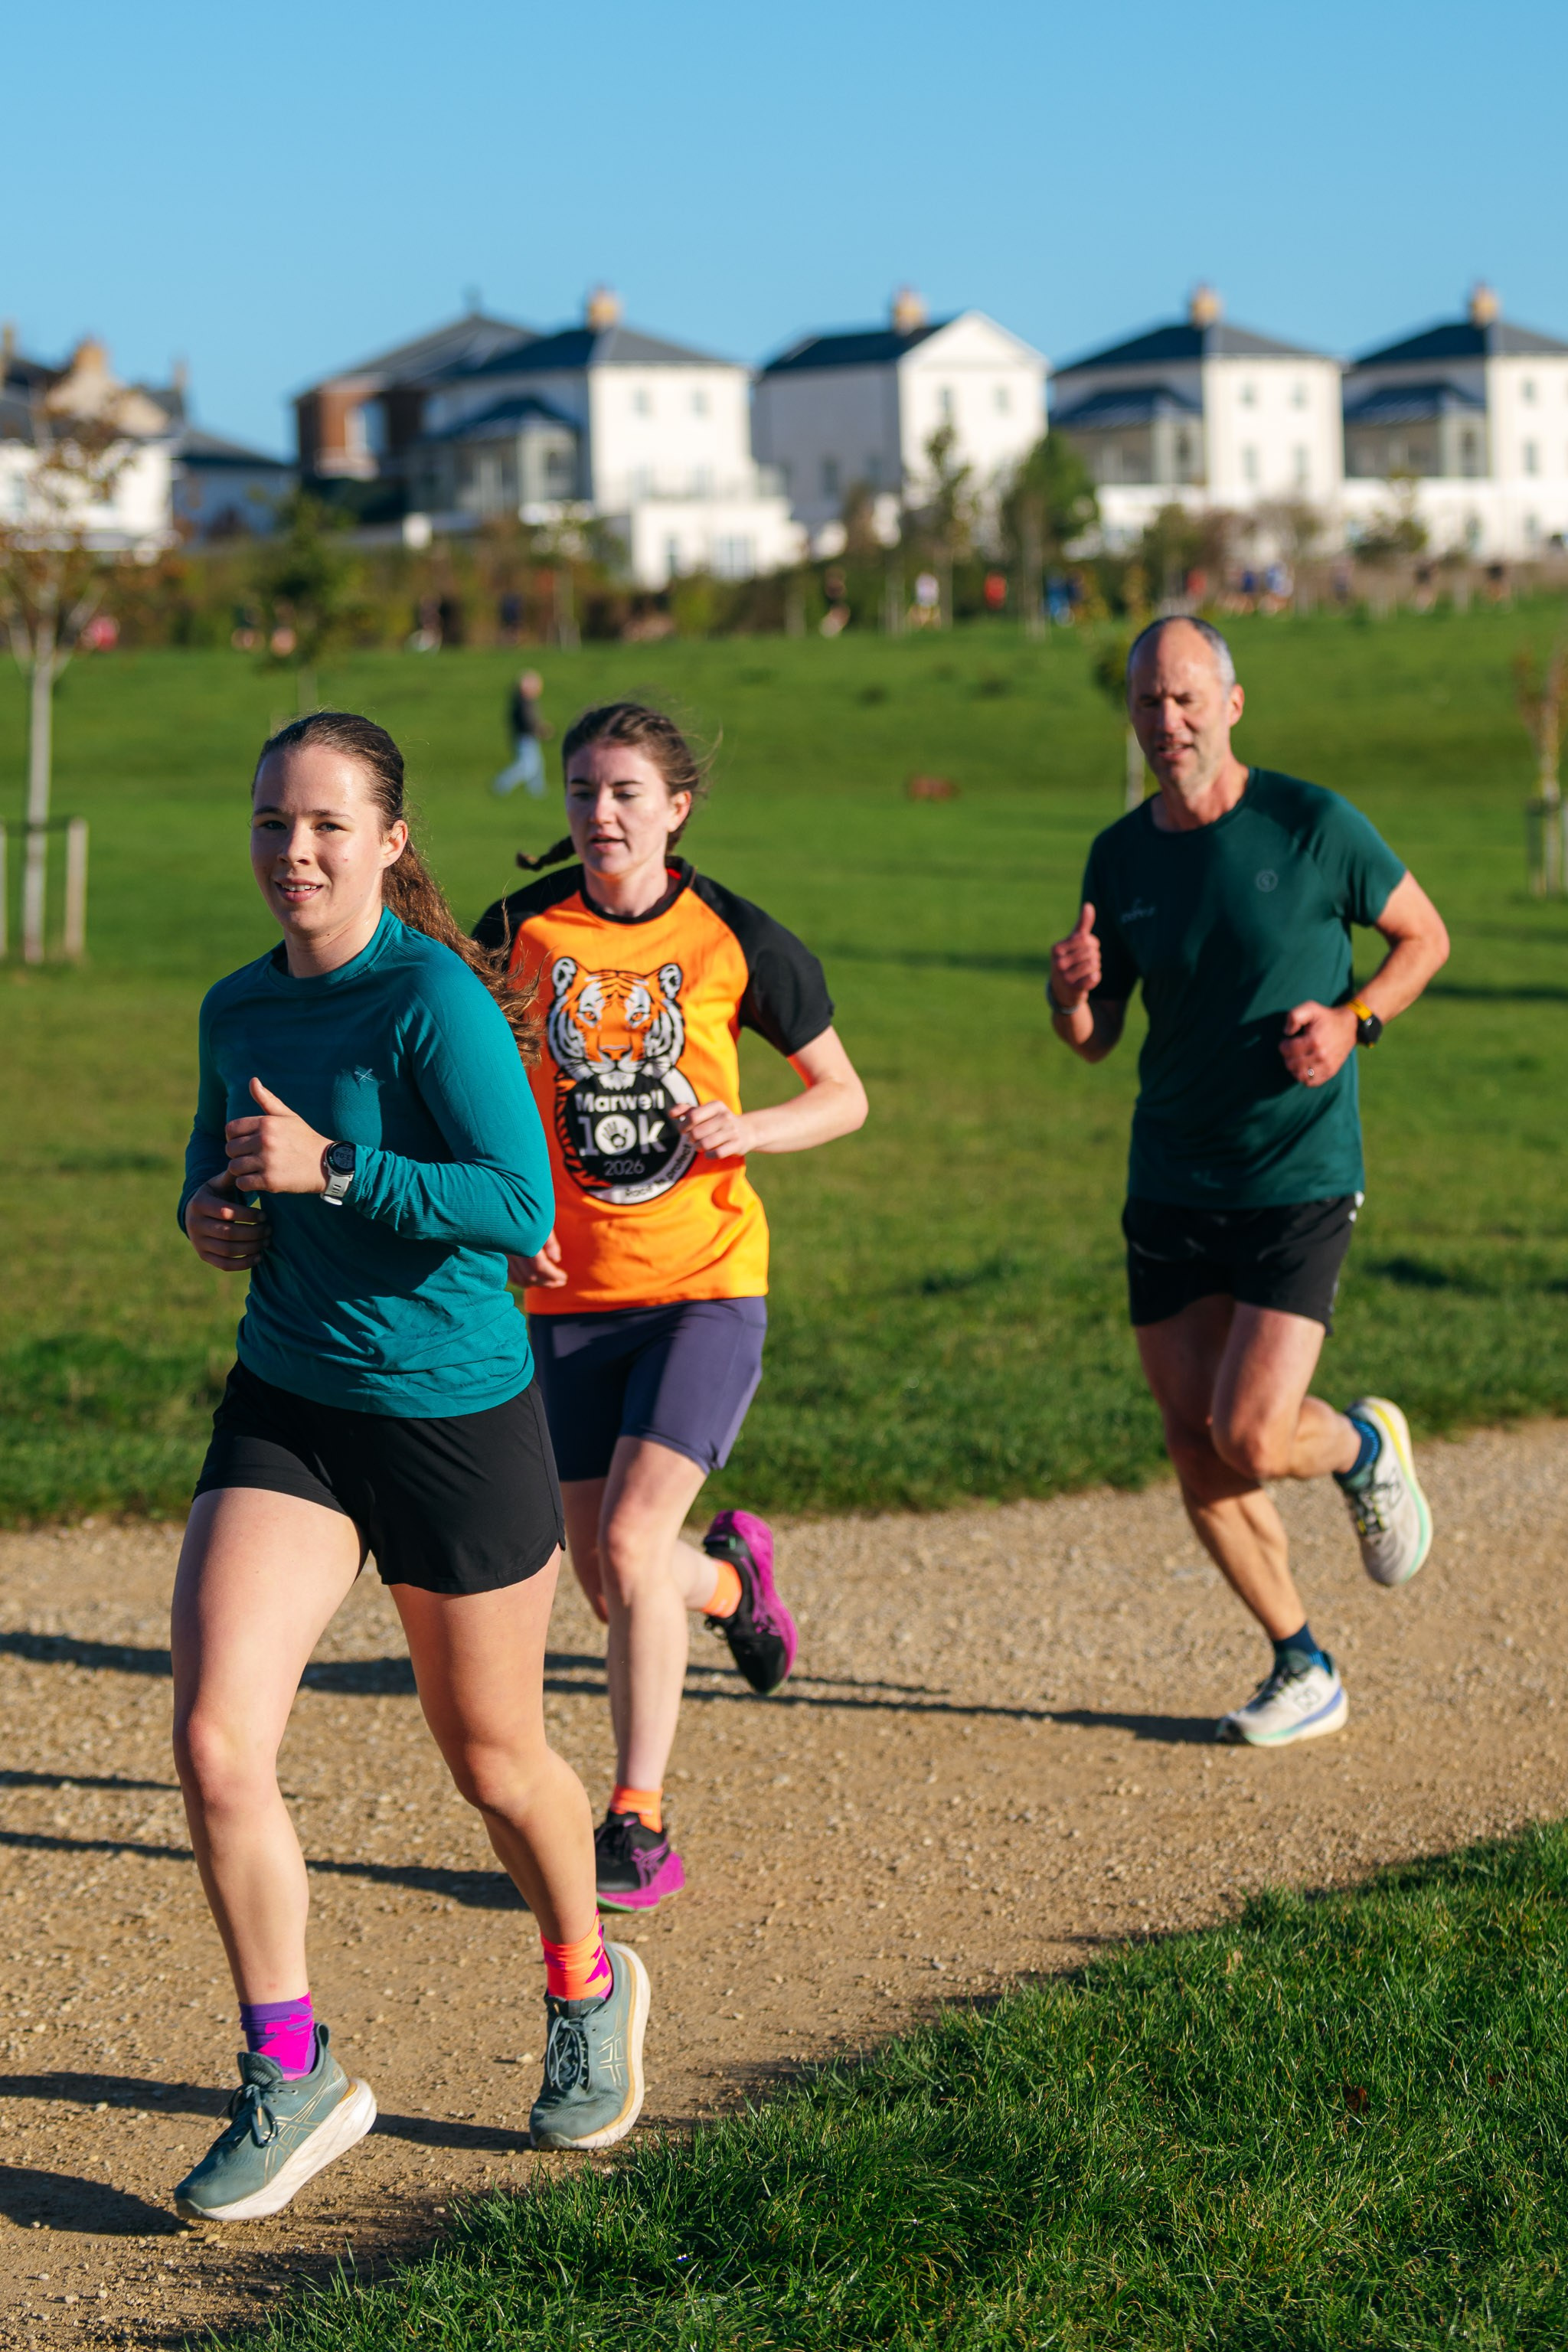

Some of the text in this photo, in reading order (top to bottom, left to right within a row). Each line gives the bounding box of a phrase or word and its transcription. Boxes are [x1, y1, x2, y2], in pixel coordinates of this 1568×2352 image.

[575, 1090, 665, 1112] Marwell
[604, 1159, 645, 1175] 2026
[666, 1144, 691, 1180] protect
